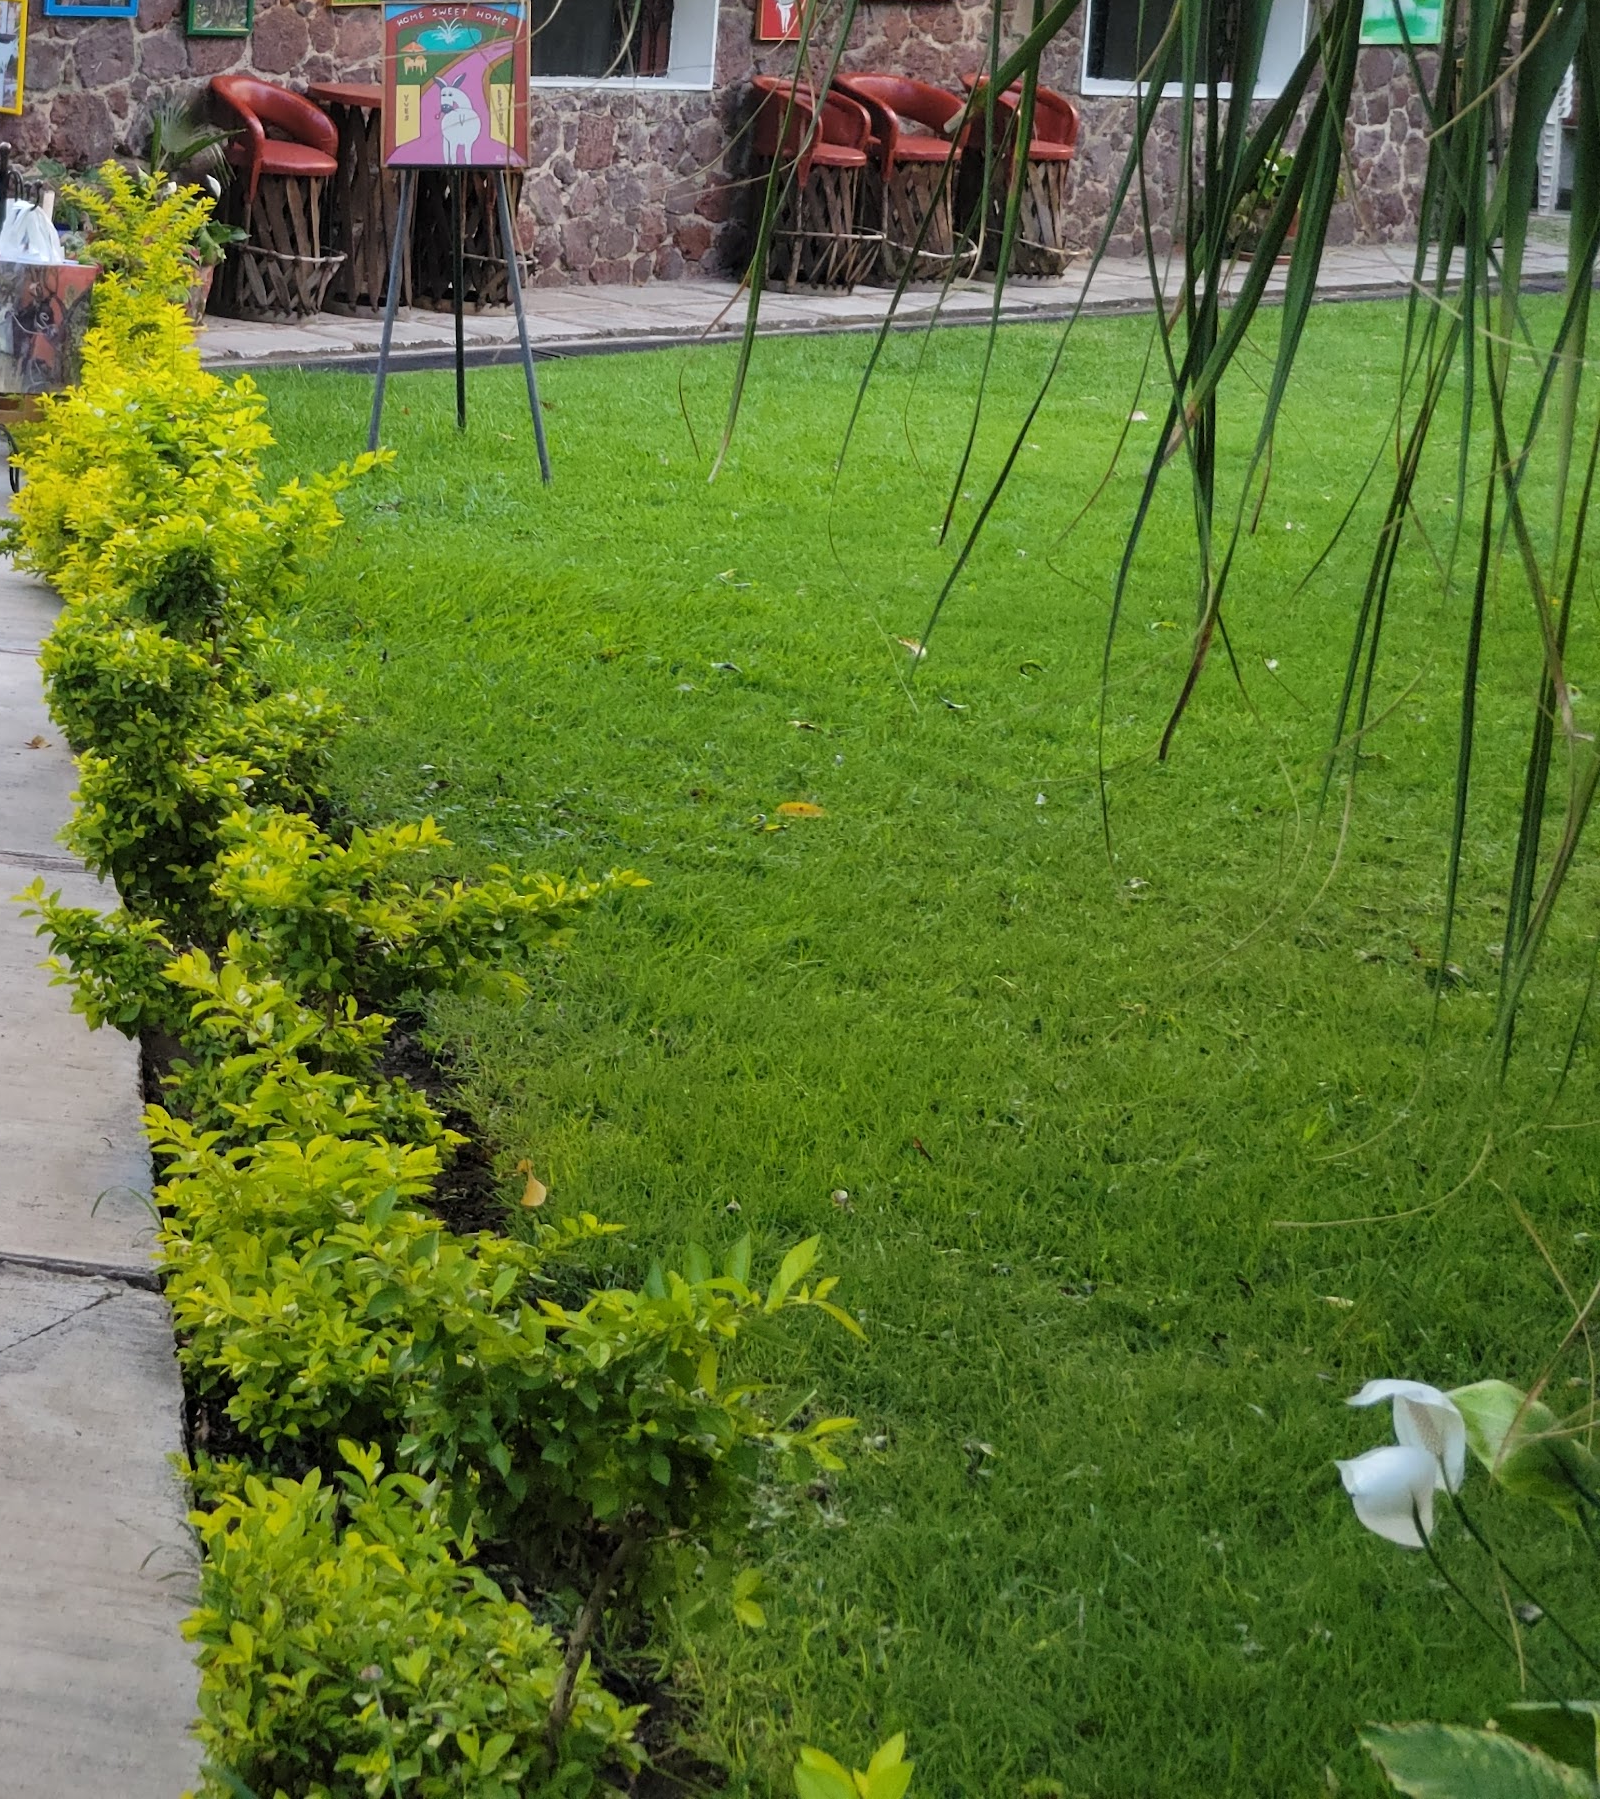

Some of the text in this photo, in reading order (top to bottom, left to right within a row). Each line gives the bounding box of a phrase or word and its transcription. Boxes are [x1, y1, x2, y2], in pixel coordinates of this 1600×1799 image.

[396, 7, 508, 27] HOME SWEET HOME
